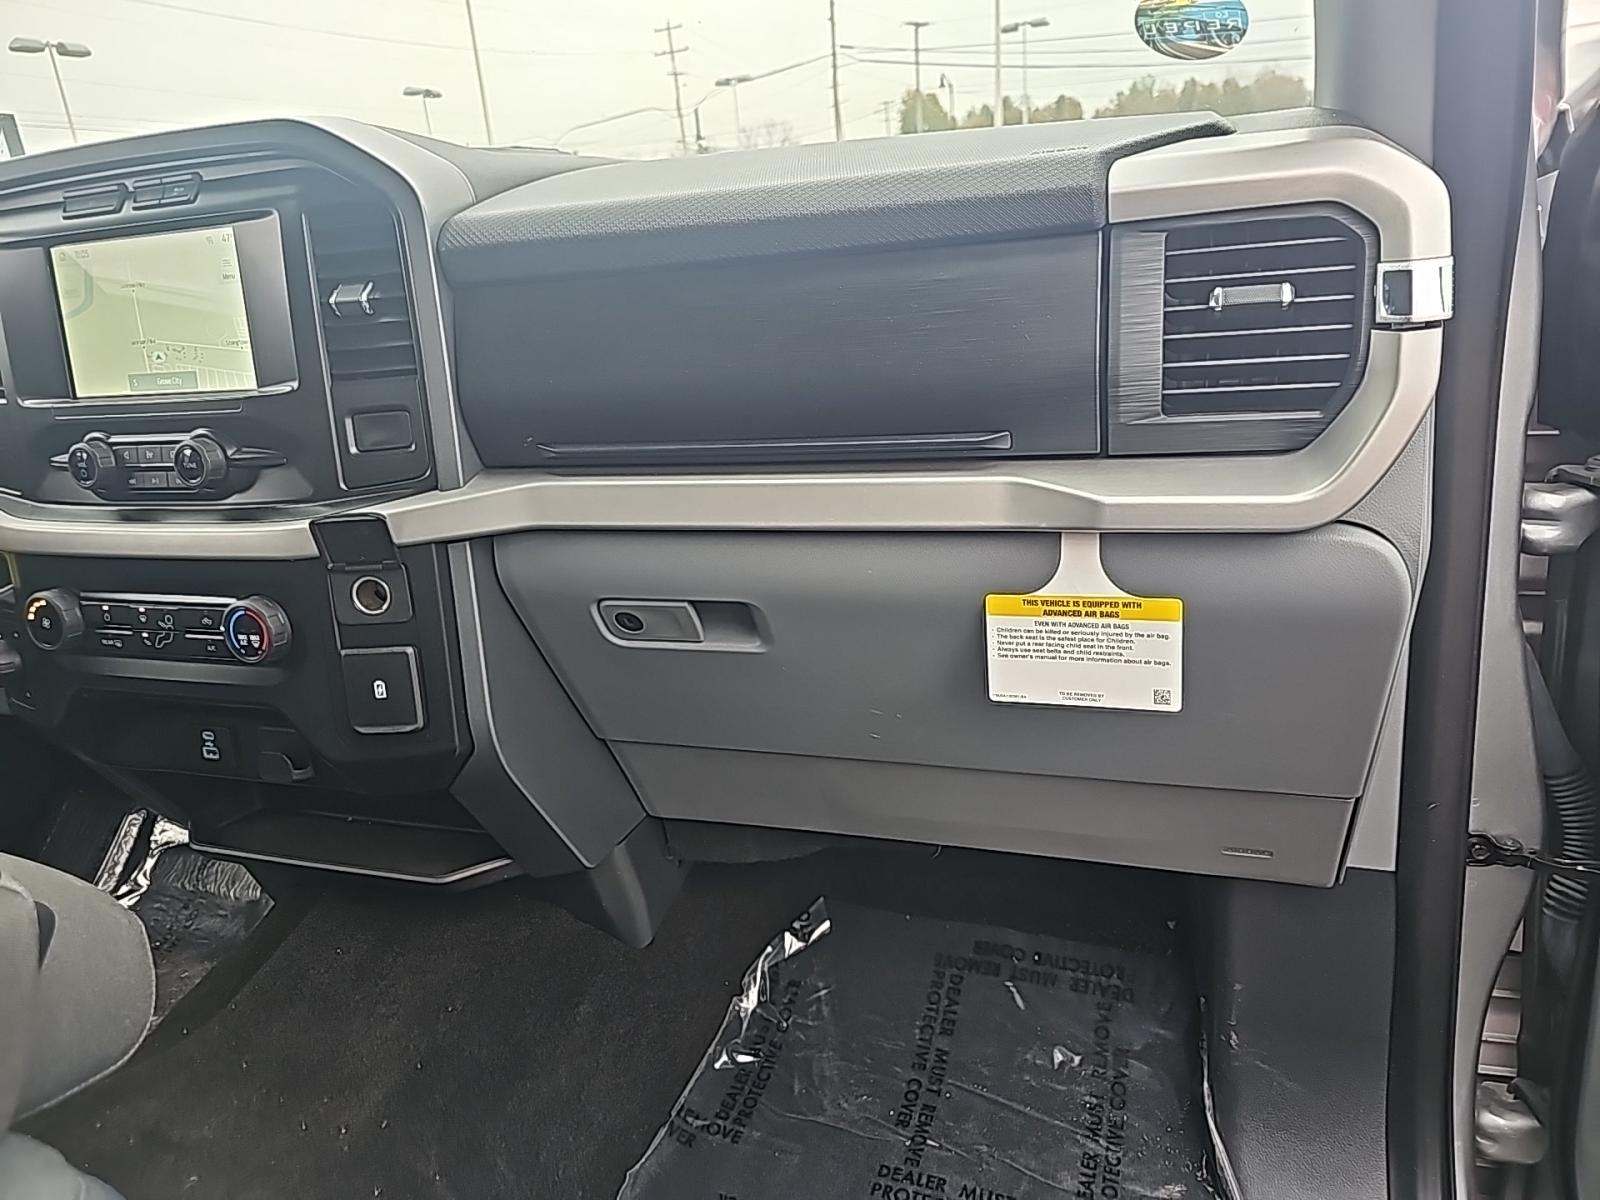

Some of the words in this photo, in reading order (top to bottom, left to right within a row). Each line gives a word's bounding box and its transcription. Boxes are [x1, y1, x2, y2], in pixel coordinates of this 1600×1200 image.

[1041, 599, 1071, 607] VEHICLE
[1082, 600, 1120, 608] EQUIPPED
[1042, 609, 1082, 617] ADVANCED
[1045, 641, 1065, 649] facing
[1071, 630, 1099, 638] seriously
[1101, 630, 1123, 638] injured
[1125, 631, 1133, 639] by
[910, 969, 946, 1072] PROTECTIVE
[939, 973, 965, 1036] DEALER
[733, 1038, 782, 1128] PROTECTIVE
[925, 1047, 951, 1097] MUST
[895, 1078, 922, 1129] COVER
[903, 1103, 937, 1168] REMOVE
[877, 1164, 947, 1193] DEALER
